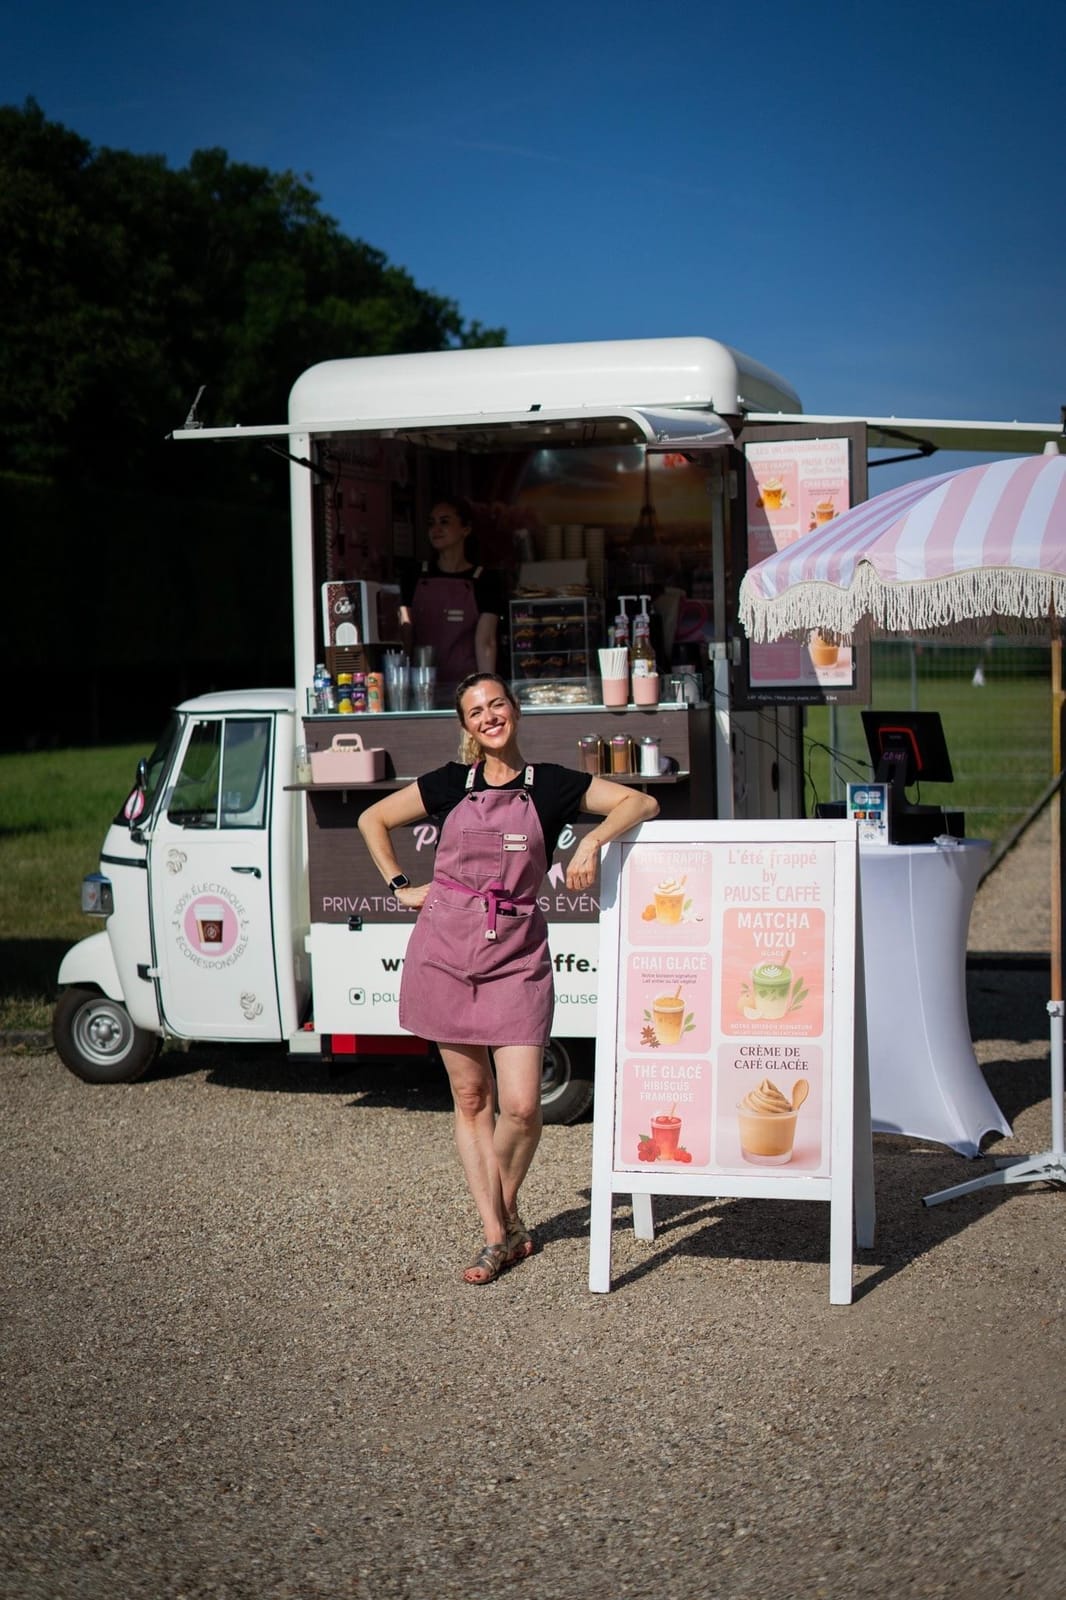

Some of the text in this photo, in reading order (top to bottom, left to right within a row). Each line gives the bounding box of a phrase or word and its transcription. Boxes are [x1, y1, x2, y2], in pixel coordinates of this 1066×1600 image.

[728, 848, 817, 869] L'été frappé
[762, 868, 777, 887] by
[174, 882, 246, 916] 100% ÉLECTRIQUE
[723, 881, 821, 902] PAUSE CAFFÈ
[322, 896, 417, 912] PRIVATISE
[536, 896, 551, 912] S
[737, 912, 810, 929] MATCHA
[381, 958, 405, 972] w
[632, 956, 662, 970] CHAI
[739, 1044, 801, 1057] CRÈME DE
[661, 1063, 703, 1080] GLACÉ
[733, 1057, 809, 1071] CAFÉ GLACÉE
[639, 1092, 695, 1103] FRAMBOISE
